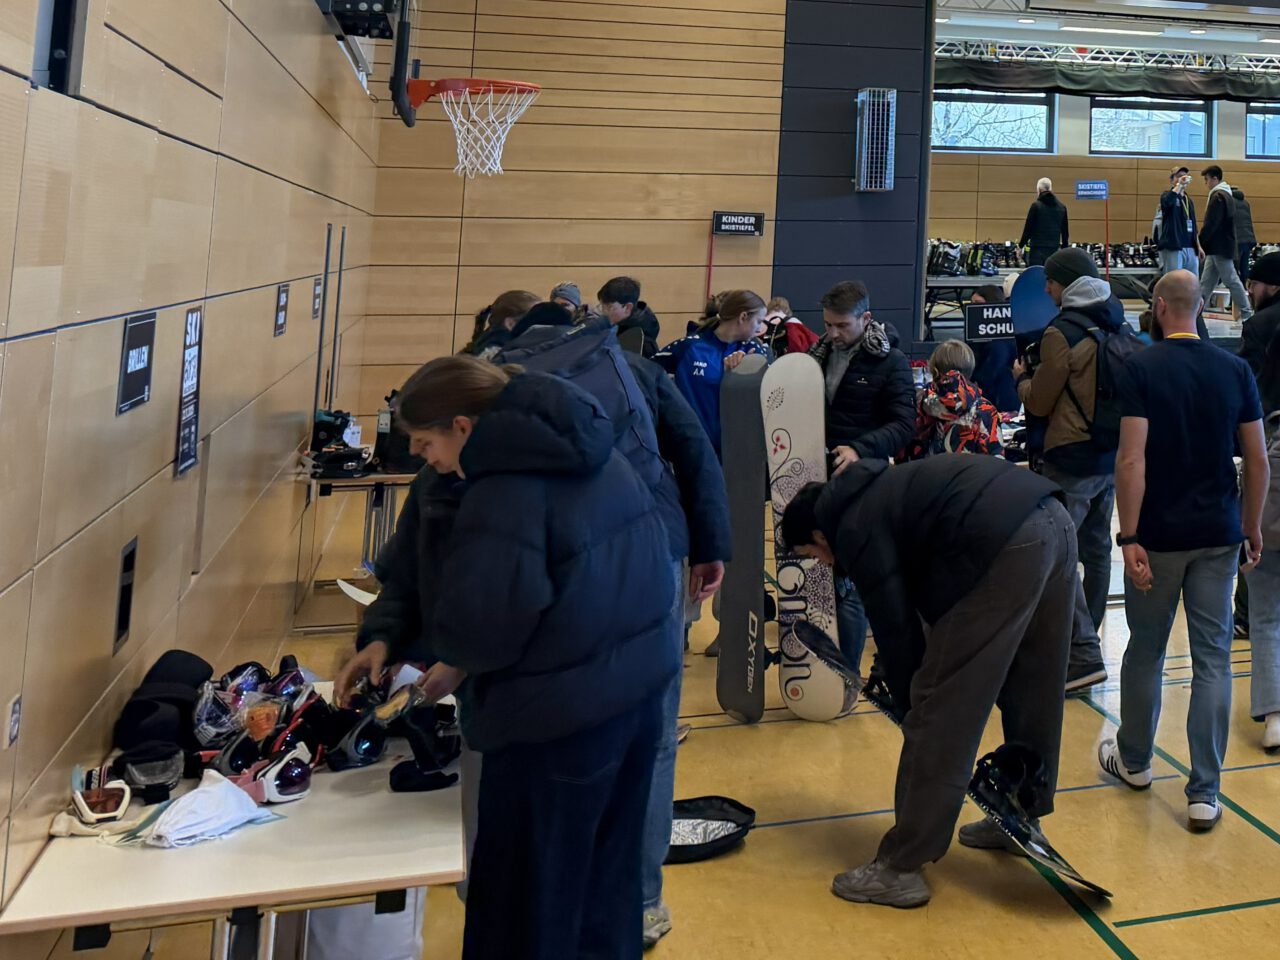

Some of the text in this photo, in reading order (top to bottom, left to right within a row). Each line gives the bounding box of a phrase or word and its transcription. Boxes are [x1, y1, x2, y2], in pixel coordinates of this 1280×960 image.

[721, 215, 756, 225] KINDER
[721, 224, 755, 232] SKISTIEFEL
[983, 307, 1012, 319] HAN
[185, 311, 200, 345] SKI
[978, 322, 1014, 335] SCHU
[746, 610, 759, 694] OXYGEN
